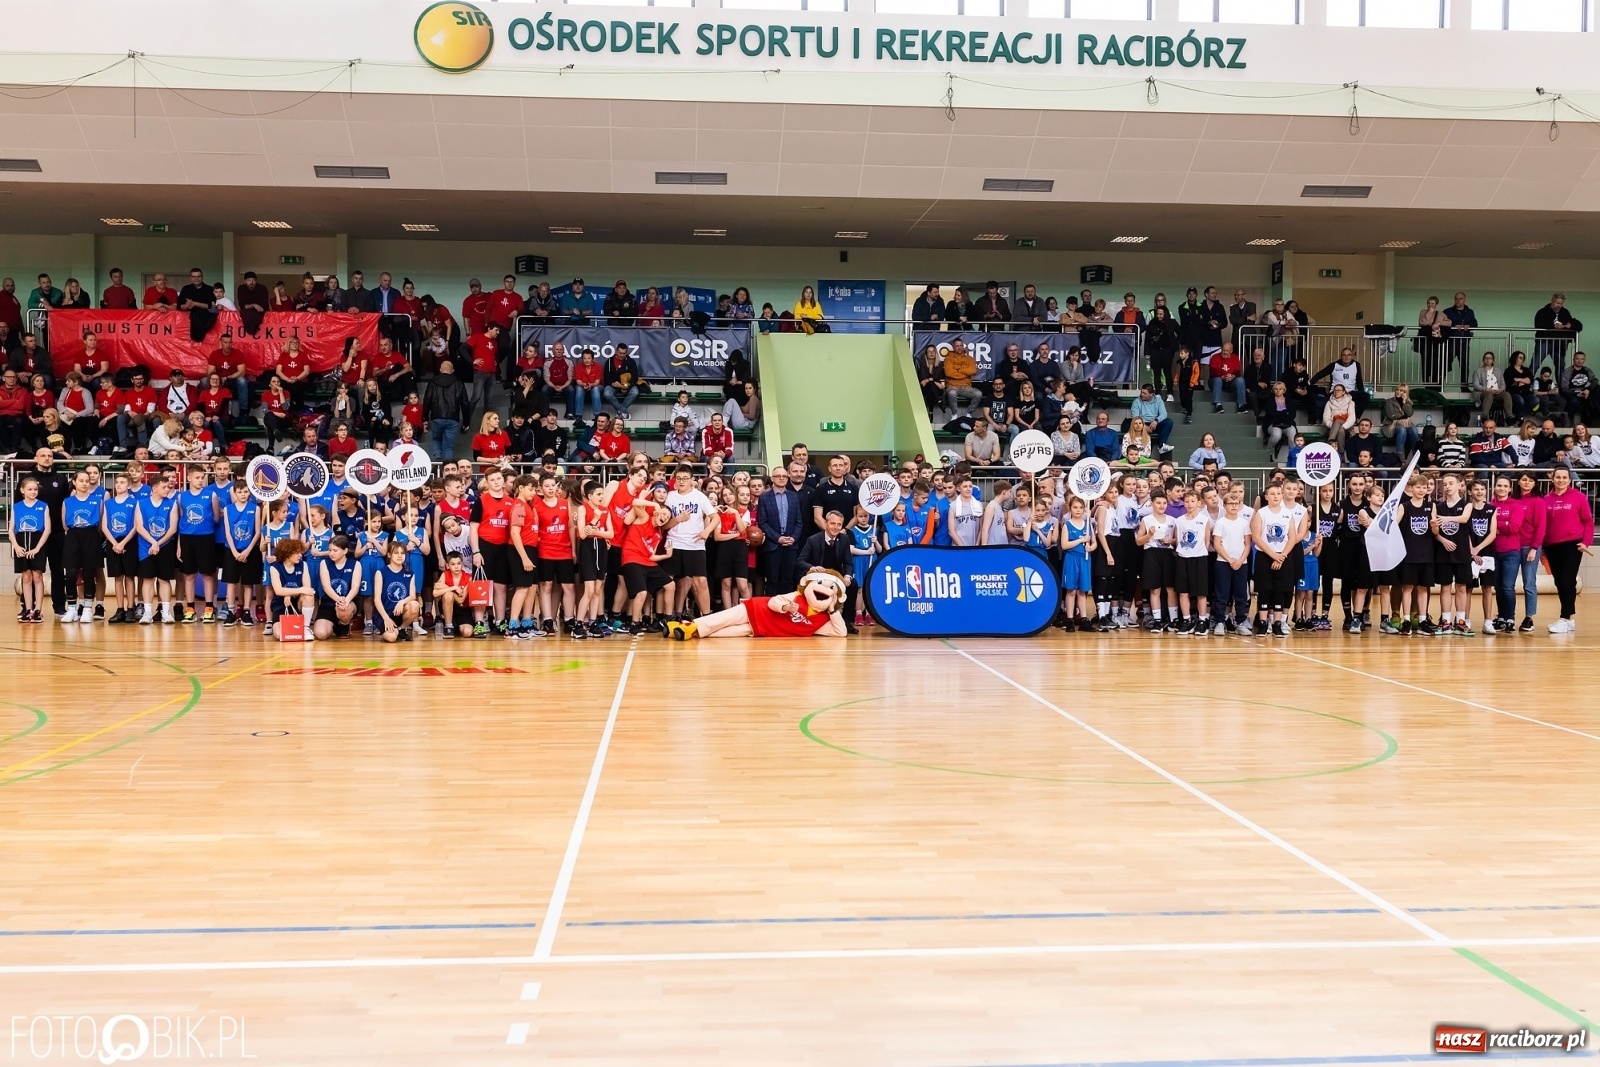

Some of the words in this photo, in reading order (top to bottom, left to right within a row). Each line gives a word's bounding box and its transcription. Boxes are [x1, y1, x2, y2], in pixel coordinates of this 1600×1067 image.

[507, 11, 681, 55] OŚRODEK
[696, 23, 839, 58] SPORTU
[853, 27, 860, 59] I
[876, 28, 1062, 65] REKREACJI
[1077, 29, 1247, 69] RACIBÓRZ
[518, 261, 526, 272] E
[534, 261, 544, 273] E
[1086, 271, 1096, 281] F
[840, 287, 851, 297] nba
[82, 322, 172, 336] HOUSTON
[544, 340, 640, 359] RACIBÓZ
[936, 342, 992, 362] OiR
[693, 359, 727, 367] RACIBÓR
[1013, 446, 1052, 459] SPURS
[391, 466, 428, 480] PORTLAND
[251, 484, 281, 498] WARRIORS
[866, 479, 897, 493] THUNDER
[862, 538, 869, 548] 8
[970, 574, 1007, 582] PROJEKT
[1299, 579, 1306, 587] 5
[884, 565, 906, 605] jr.
[924, 566, 961, 599] nba
[975, 589, 1008, 597] POLSKA
[908, 600, 934, 615] League
